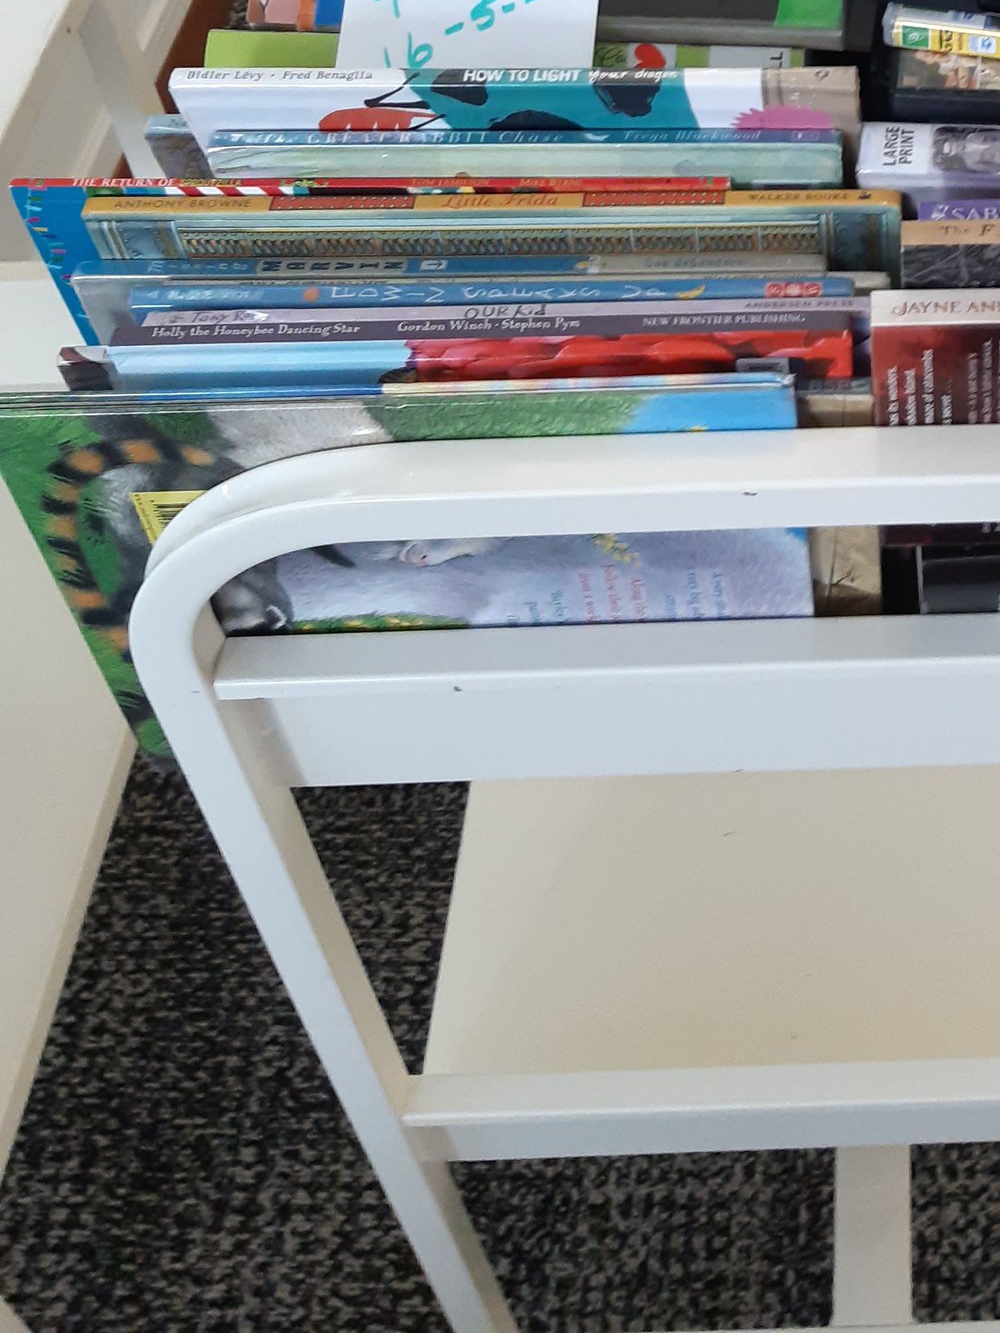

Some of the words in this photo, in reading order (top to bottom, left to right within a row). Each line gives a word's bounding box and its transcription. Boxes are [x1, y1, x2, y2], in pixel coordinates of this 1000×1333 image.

[235, 70, 262, 83] Lévy
[282, 70, 314, 80] Fred
[463, 68, 503, 83] HOW
[506, 68, 530, 82] TO
[533, 68, 579, 82] LIGHT
[588, 69, 628, 84] your
[634, 67, 678, 83] dragon
[400, 130, 487, 143] RABBIT
[499, 130, 564, 143] Chase
[623, 130, 670, 142] Freya
[675, 129, 762, 141] Blackwood
[883, 125, 900, 166] LARGE
[898, 127, 916, 165] PRINT
[72, 178, 97, 187] THE
[100, 178, 152, 187] RETURN
[157, 178, 176, 187] OF
[114, 199, 184, 209] ANTHONY
[189, 198, 251, 208] BROWNE
[441, 194, 491, 209] Little
[500, 194, 559, 207] Frida
[750, 192, 800, 201] WALKER
[260, 259, 406, 273] MARVIN
[331, 285, 446, 304] EDWIN
[463, 285, 600, 300] SPEAKS
[621, 283, 667, 299] UP
[464, 305, 511, 319] OUR
[514, 303, 547, 317] Kid
[891, 299, 961, 316] JAYNE
[190, 310, 228, 324] Tony
[642, 316, 669, 327] NEW
[672, 315, 732, 327] FRONTIER
[735, 313, 807, 324] PUBLISHING
[152, 325, 187, 340] Holly
[190, 326, 210, 336] the
[213, 324, 274, 338] Honeybee
[278, 323, 330, 337] Dancing
[333, 322, 361, 334] Star
[397, 321, 446, 332] Gordon
[450, 319, 492, 330] Winch
[501, 319, 551, 332] Stephen
[555, 318, 581, 331] Pym
